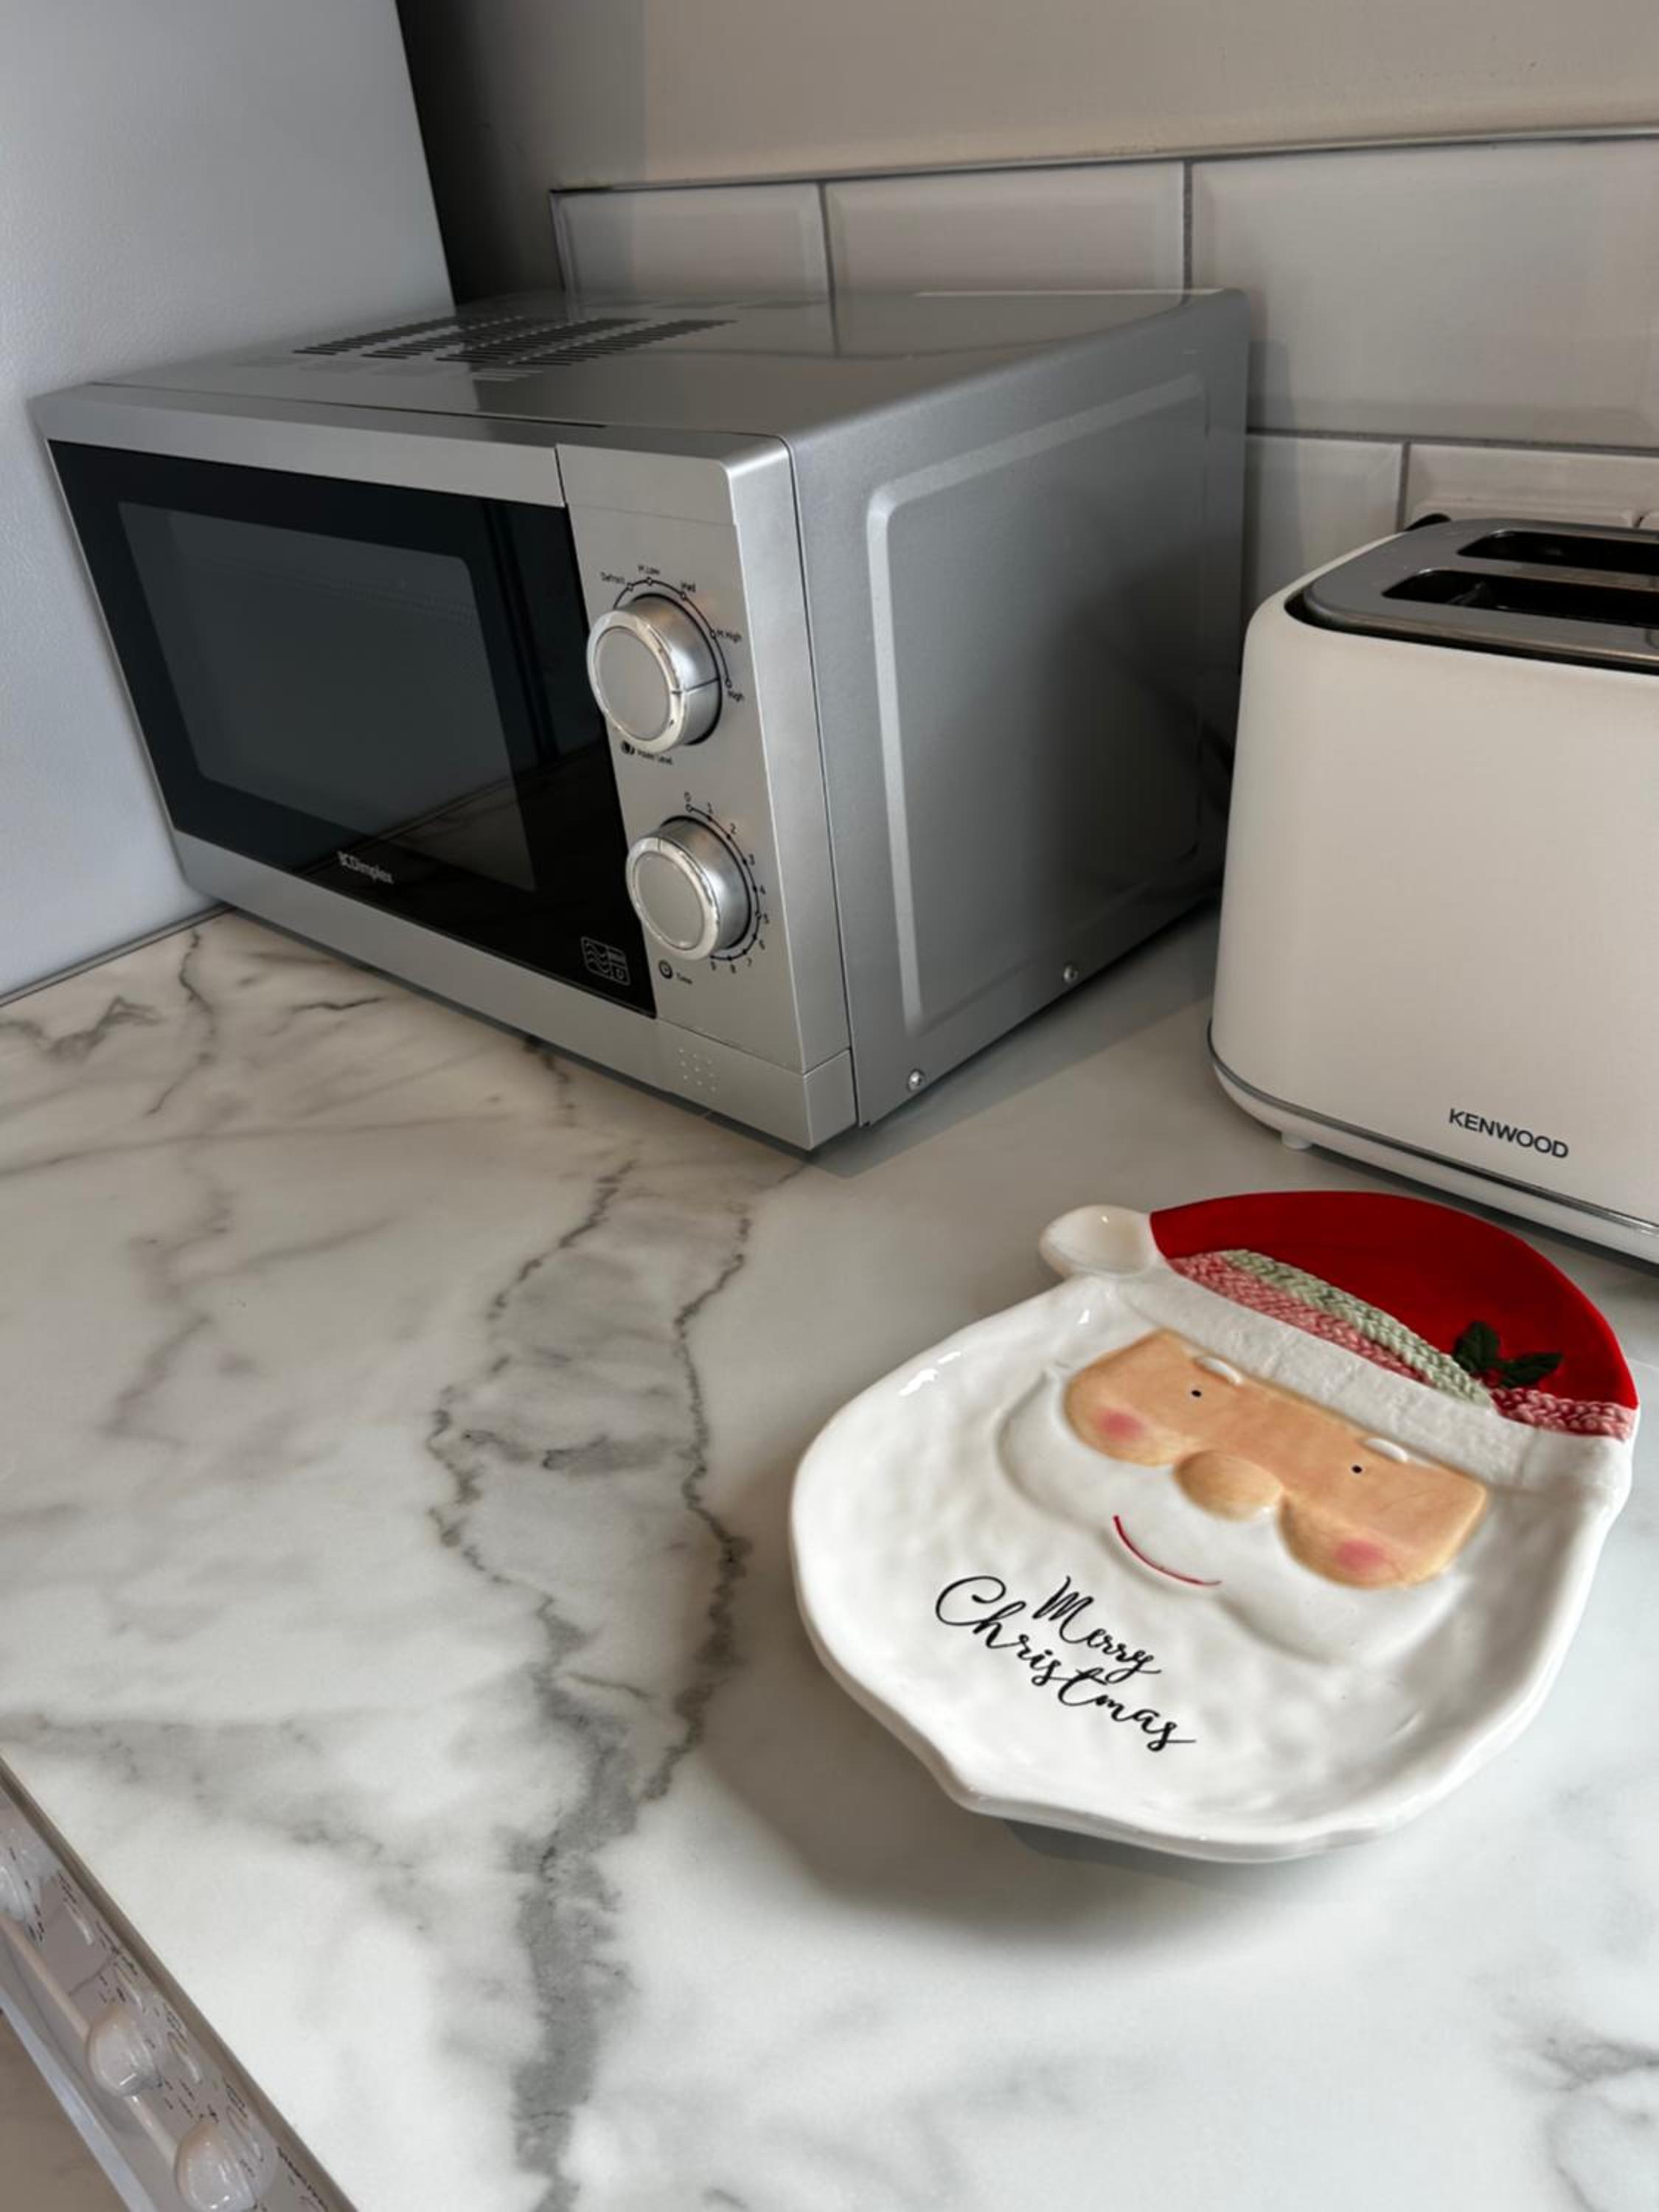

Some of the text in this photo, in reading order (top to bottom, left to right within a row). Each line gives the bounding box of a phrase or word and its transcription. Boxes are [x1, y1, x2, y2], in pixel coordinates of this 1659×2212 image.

[706, 802, 714, 814] 1
[729, 822, 737, 835] 2
[1448, 1107, 1569, 1158] KENWOOD
[1032, 1575, 1162, 1685] Merry
[935, 1575, 1197, 1752] Christmas
